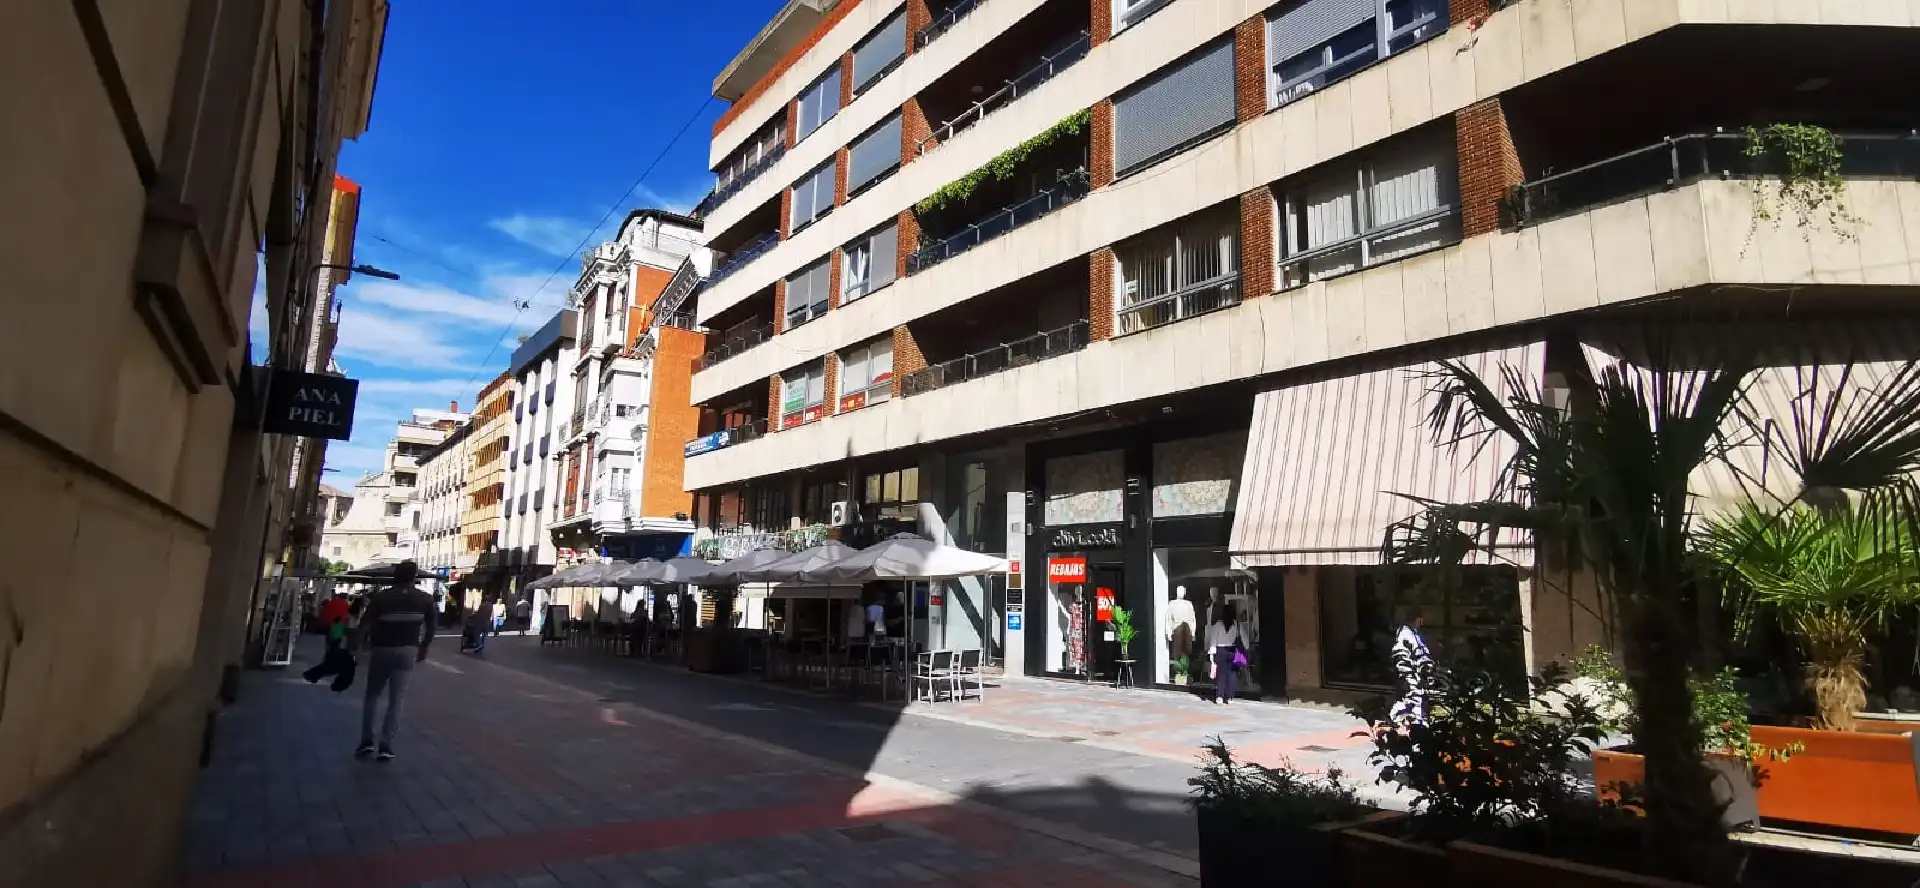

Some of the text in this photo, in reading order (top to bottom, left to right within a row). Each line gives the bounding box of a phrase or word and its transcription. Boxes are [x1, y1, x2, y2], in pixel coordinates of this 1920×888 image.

[296, 387, 341, 404] ANA
[288, 407, 341, 425] PIEL
[1050, 563, 1085, 576] REBAJAS
